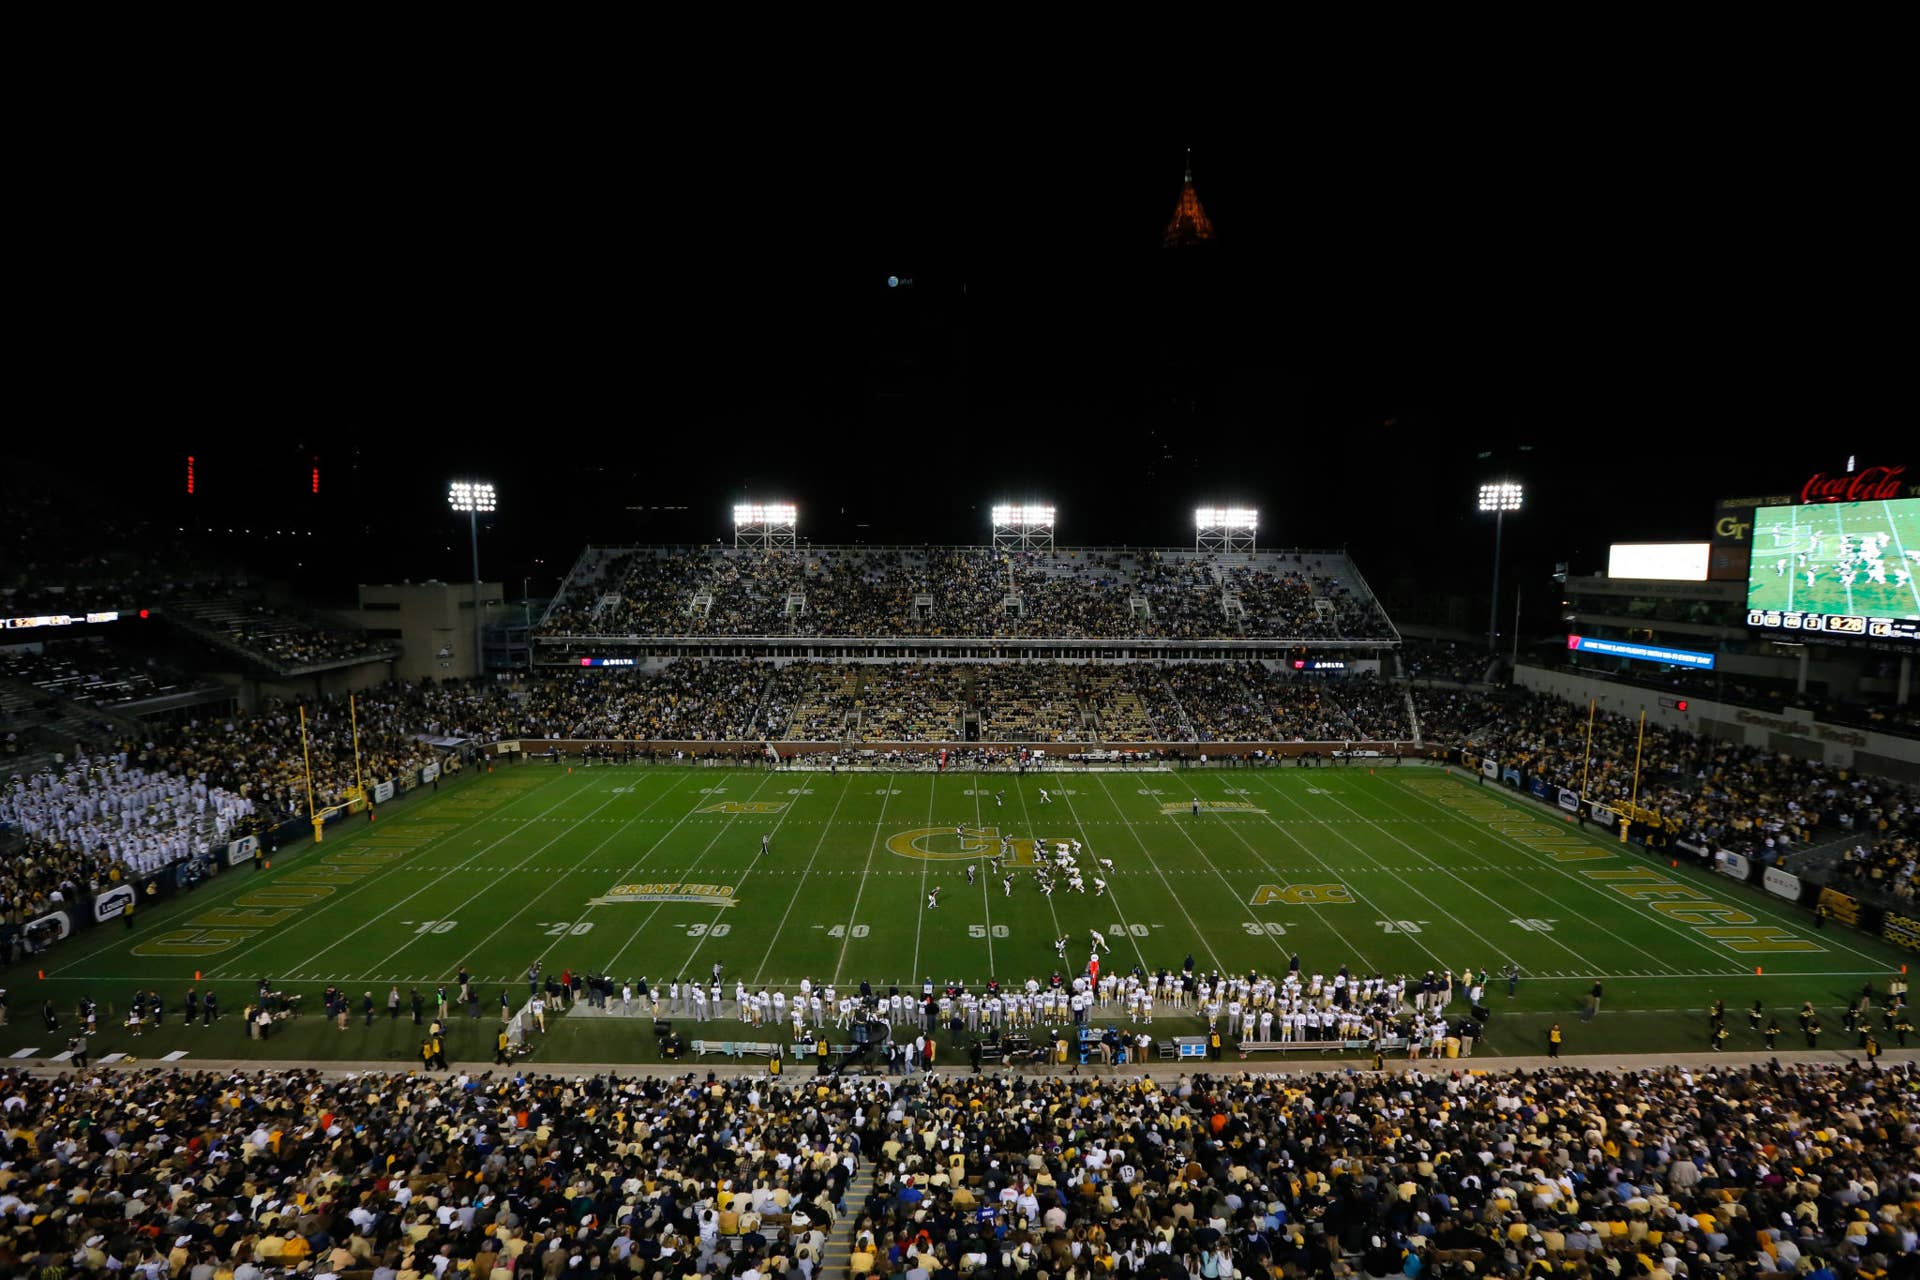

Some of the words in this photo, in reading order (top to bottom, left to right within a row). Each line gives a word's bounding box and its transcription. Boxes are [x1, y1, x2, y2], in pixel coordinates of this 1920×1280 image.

[1765, 495, 1792, 505] TECH
[1716, 516, 1749, 540] GT
[885, 826, 1078, 868] GT
[609, 883, 682, 896] GRANT
[679, 884, 734, 897] FIELD
[1249, 884, 1356, 905] ACC
[1578, 866, 1830, 953] TECH
[414, 920, 458, 934] 10
[544, 922, 594, 936] 20
[686, 923, 732, 937] 30
[827, 924, 870, 938] 40
[968, 924, 1010, 938] 50
[1109, 923, 1150, 937] 40
[1242, 922, 1287, 936] 30
[1376, 920, 1423, 934] 20
[1509, 918, 1556, 932] 10
